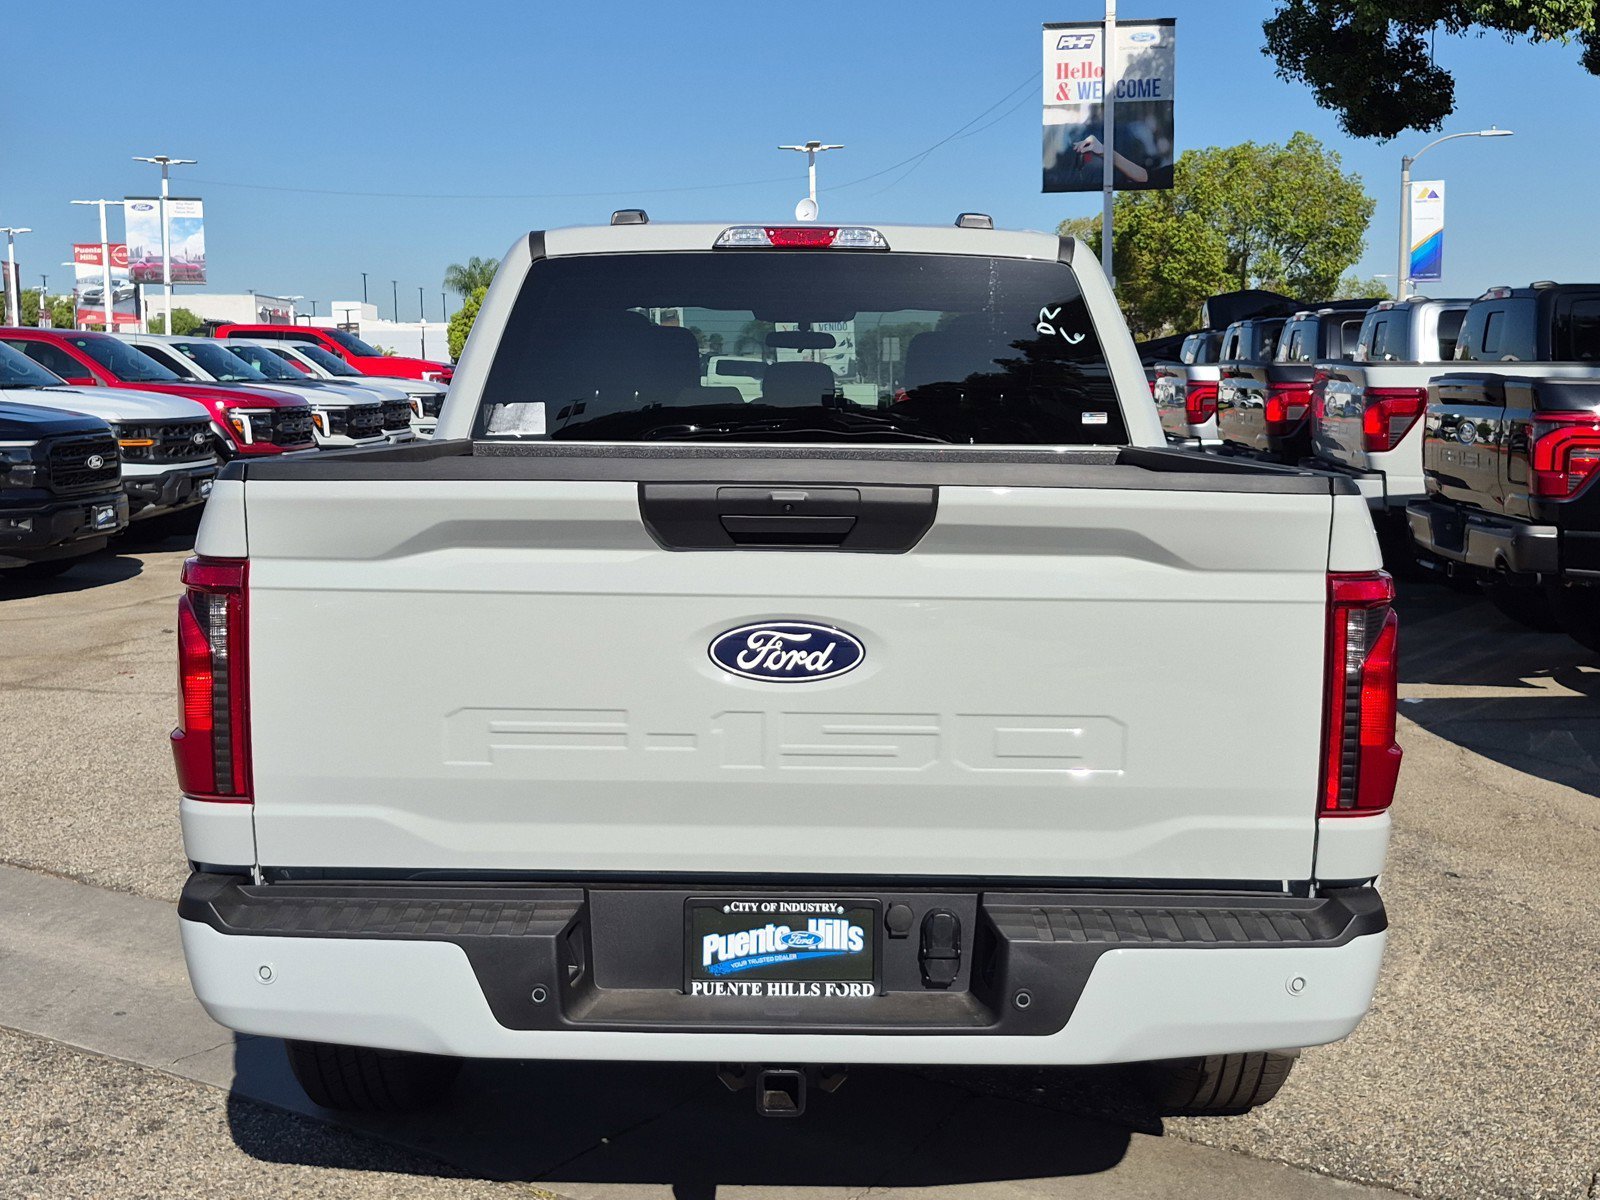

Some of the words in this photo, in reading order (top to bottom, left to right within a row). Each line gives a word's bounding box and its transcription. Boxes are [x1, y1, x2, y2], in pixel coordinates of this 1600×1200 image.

[1056, 61, 1105, 79] Hello
[1056, 81, 1070, 101] &
[1077, 79, 1161, 100] WECOME
[736, 630, 836, 671] Ford
[443, 707, 1127, 775] F-150
[730, 901, 759, 912] CITY
[761, 902, 778, 912] OF
[779, 902, 838, 912] INDUSTRY
[703, 923, 791, 966] Puente
[787, 933, 815, 945] Ford
[807, 918, 864, 951] Hills
[748, 956, 774, 966] TRUSTED
[774, 953, 798, 963] DEALER
[691, 981, 763, 997] PUENTE
[766, 982, 821, 997] HILLS
[824, 982, 875, 997] FORD
